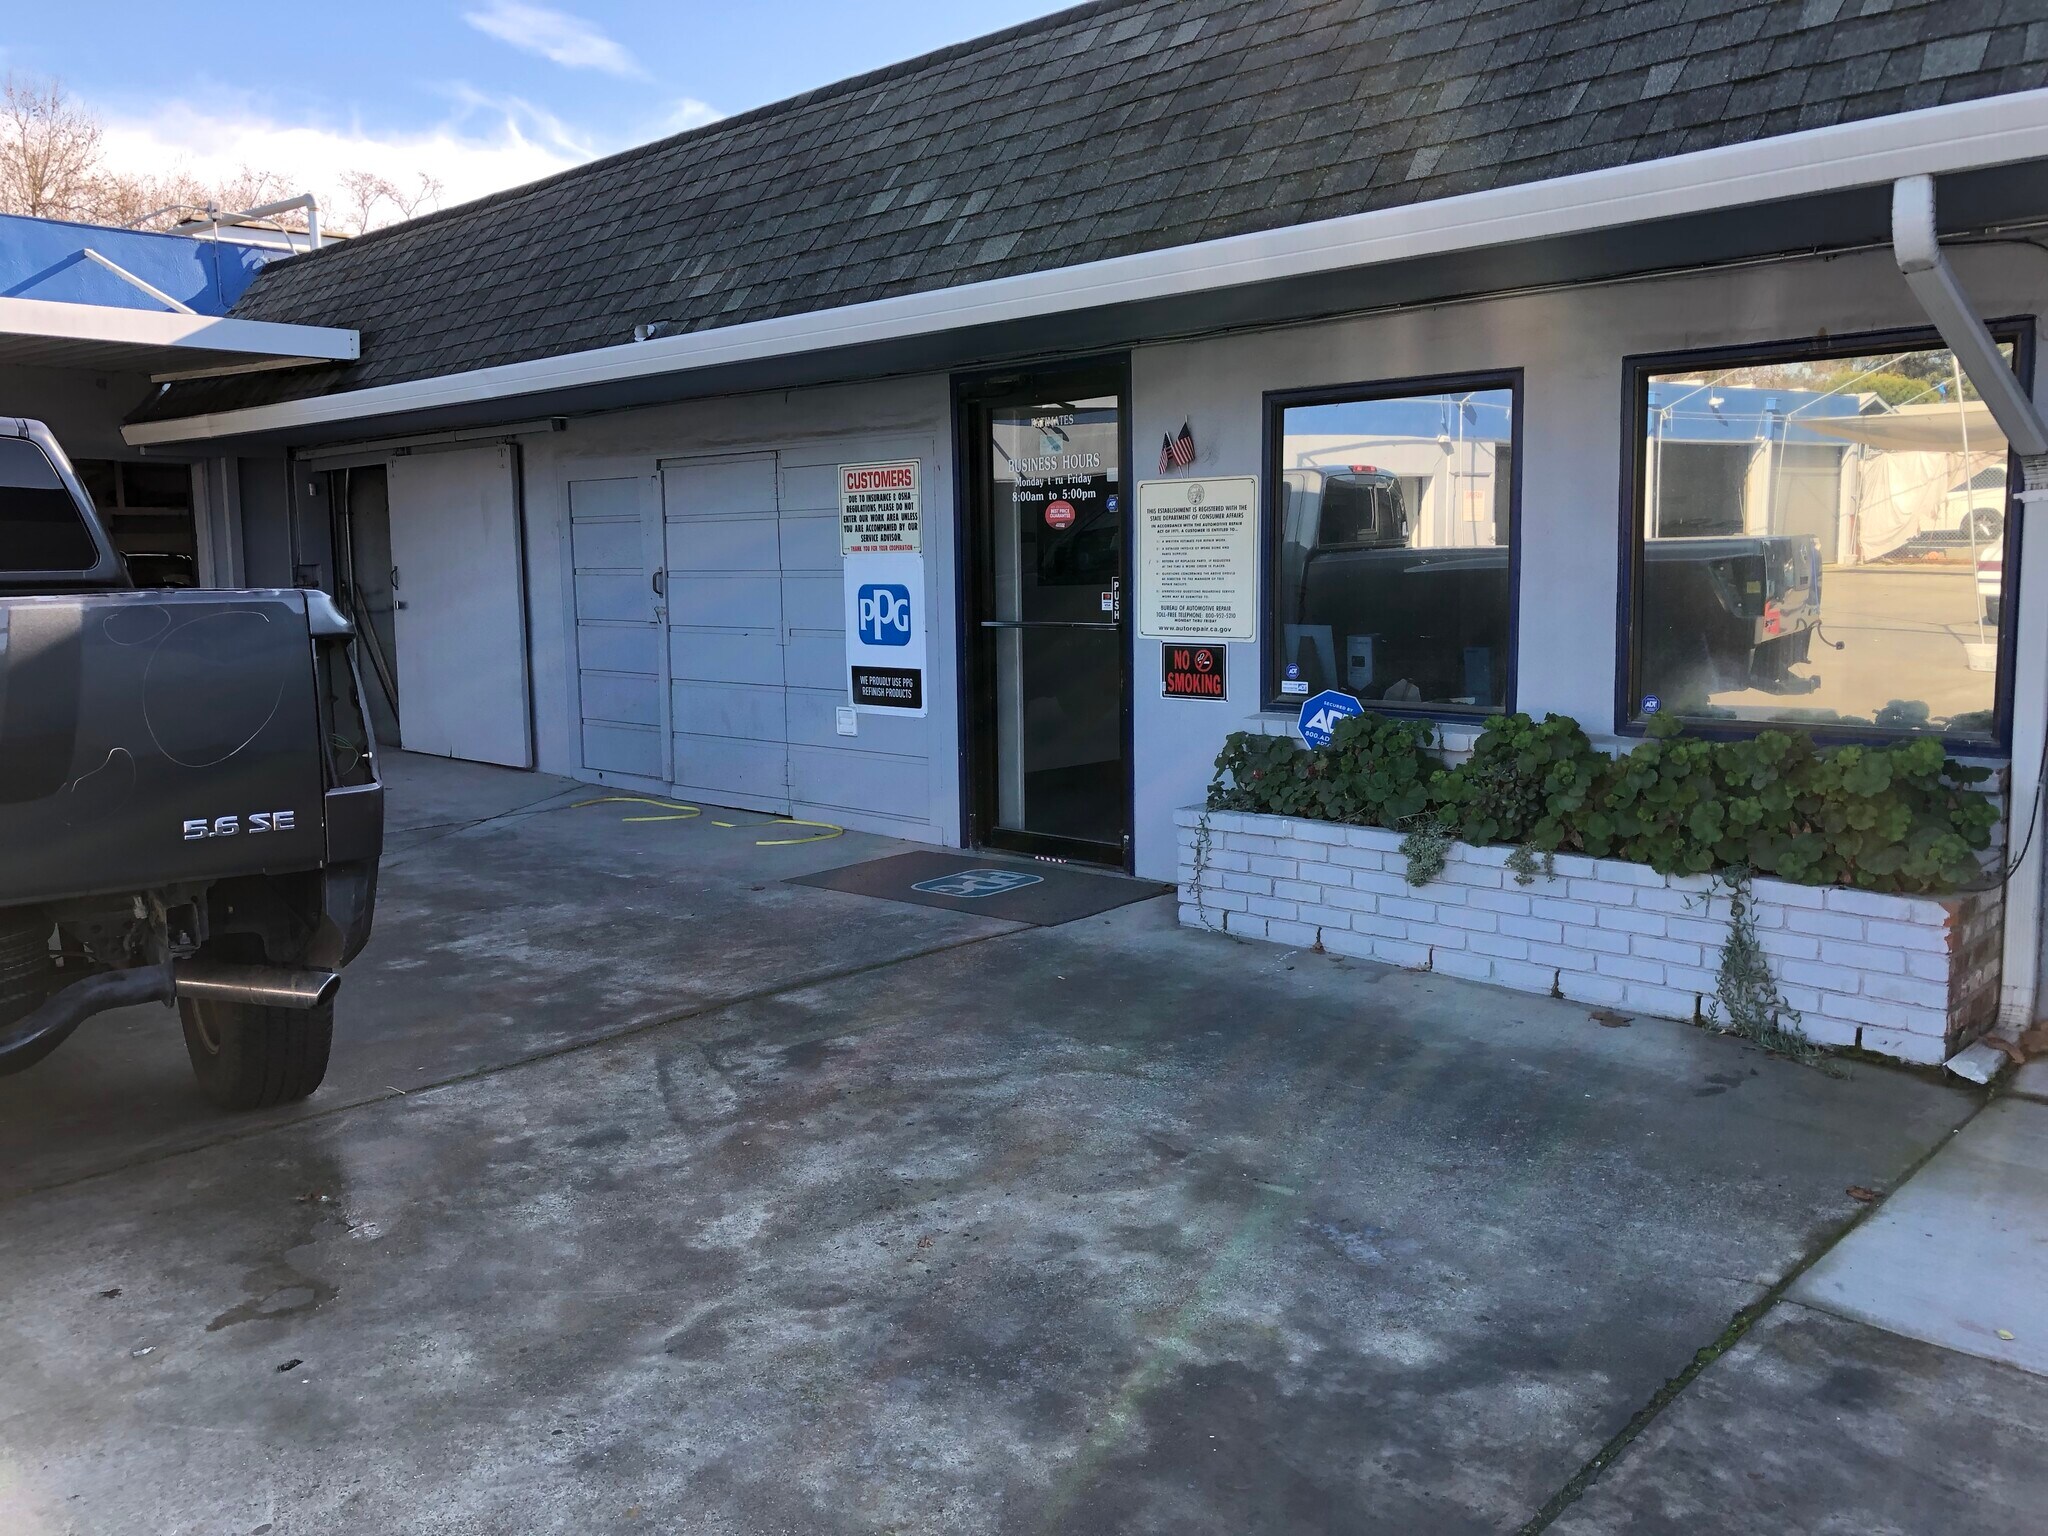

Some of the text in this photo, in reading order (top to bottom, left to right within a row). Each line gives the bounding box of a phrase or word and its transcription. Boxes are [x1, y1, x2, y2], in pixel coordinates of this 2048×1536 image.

[1008, 452, 1100, 472] BUSINESS HOURS
[847, 469, 912, 489] CUSTOMERS
[1016, 475, 1044, 488] Monday
[1067, 474, 1092, 484] Friday
[848, 495, 858, 503] DUE
[859, 494, 865, 503] TO
[866, 493, 891, 502] INSURANCE
[898, 492, 911, 500] OSHA
[1012, 488, 1096, 502] 8:00am to 5:00pm
[878, 503, 894, 511] PLEASE
[896, 503, 902, 511] DO
[904, 502, 914, 510] NOT
[844, 515, 857, 523] ENTER
[870, 514, 884, 522] WORK
[887, 513, 899, 521] AREA
[901, 512, 918, 520] UNLESS
[844, 522, 918, 533] YOU ARE ACCOMPANIED BY OUR
[861, 534, 878, 542] SERVICE
[860, 590, 908, 640] PPG
[1174, 650, 1189, 670] NO
[860, 676, 913, 688] WE PROUDLY USE PPG
[1168, 672, 1221, 694] SMOKING
[862, 687, 912, 698] REFINISH PRODUCTS
[1324, 701, 1346, 711] SECURED
[1305, 708, 1356, 734] AD
[184, 811, 294, 840] 5.6 SE
